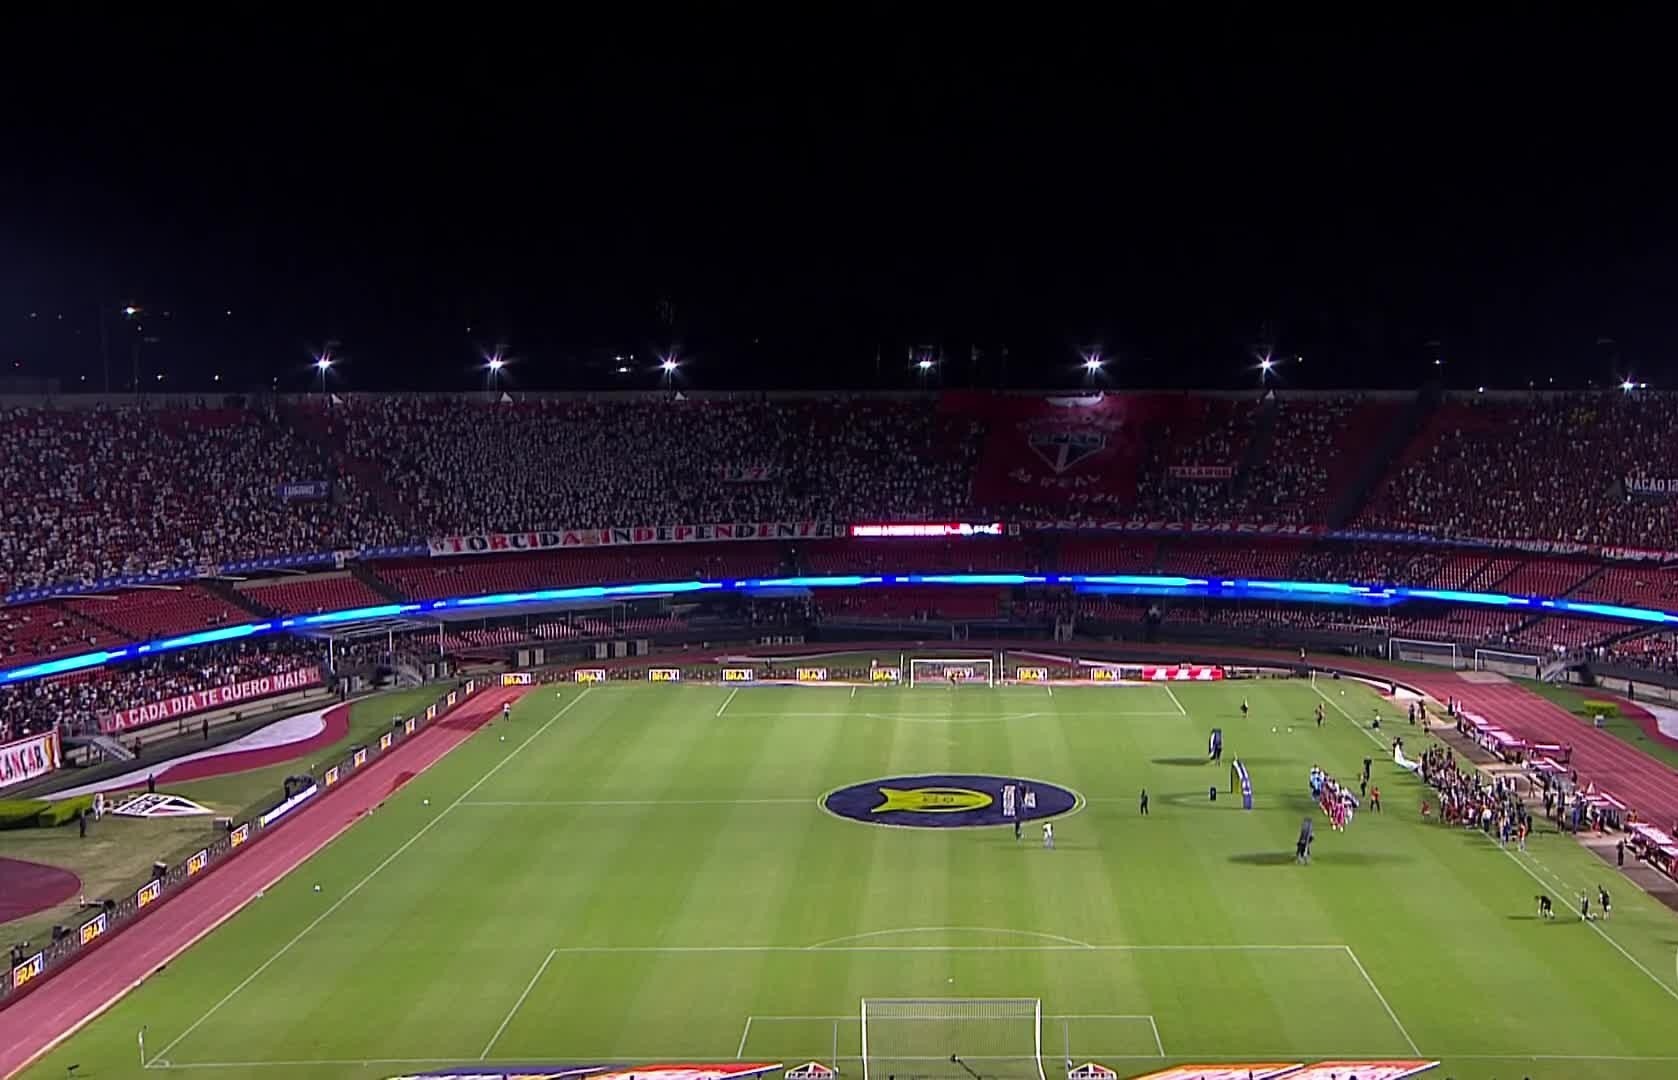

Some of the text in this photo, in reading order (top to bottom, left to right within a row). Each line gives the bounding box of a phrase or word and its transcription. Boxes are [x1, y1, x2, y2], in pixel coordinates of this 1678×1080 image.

[446, 530, 582, 552] TORCIDA
[602, 521, 832, 545] INDEPENDENTE
[129, 704, 168, 725] CADA
[173, 693, 196, 714] DIA
[200, 690, 218, 706] TE
[222, 677, 269, 701] QUERO
[273, 668, 307, 691] MAIS
[0, 745, 44, 782] ANÇAR
[17, 957, 42, 985] BRAX
